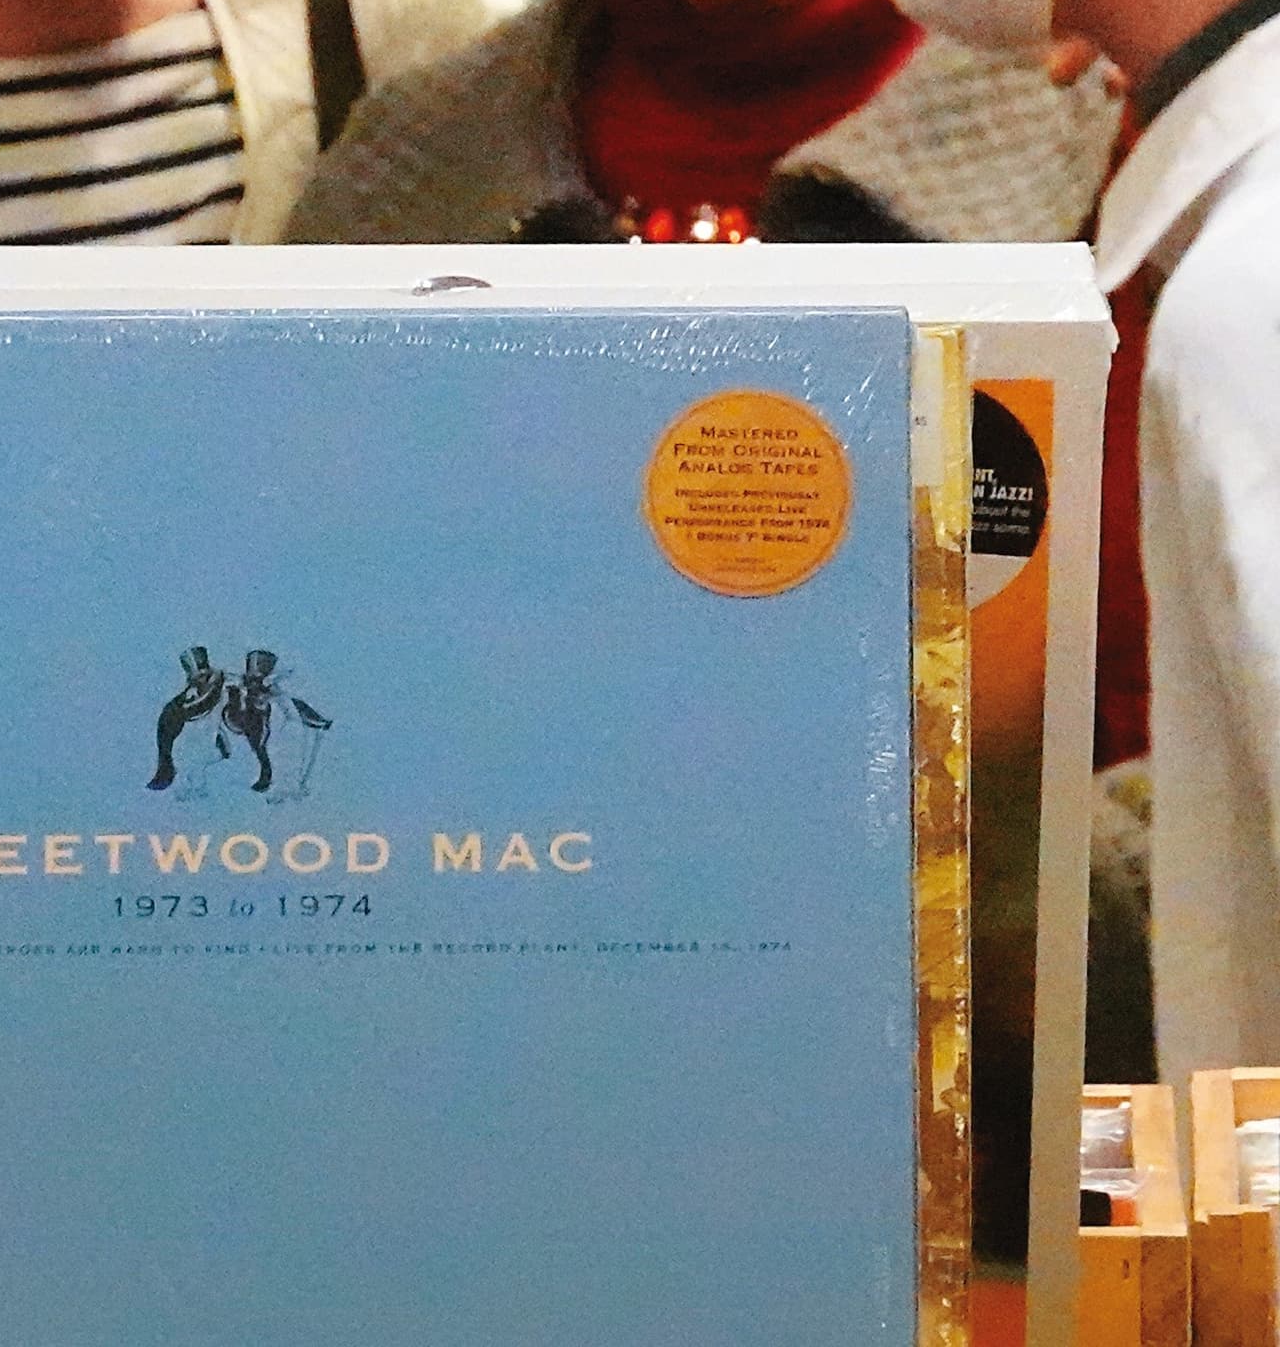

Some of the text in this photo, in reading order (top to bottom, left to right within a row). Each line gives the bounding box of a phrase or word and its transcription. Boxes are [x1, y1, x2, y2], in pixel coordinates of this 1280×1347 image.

[700, 426, 799, 441] MASTERED
[673, 443, 823, 459] FROM ORIGINAL
[678, 461, 819, 476] ANALOG TAPES
[431, 832, 593, 873] MAC
[113, 893, 372, 918] 1973 to 1974
